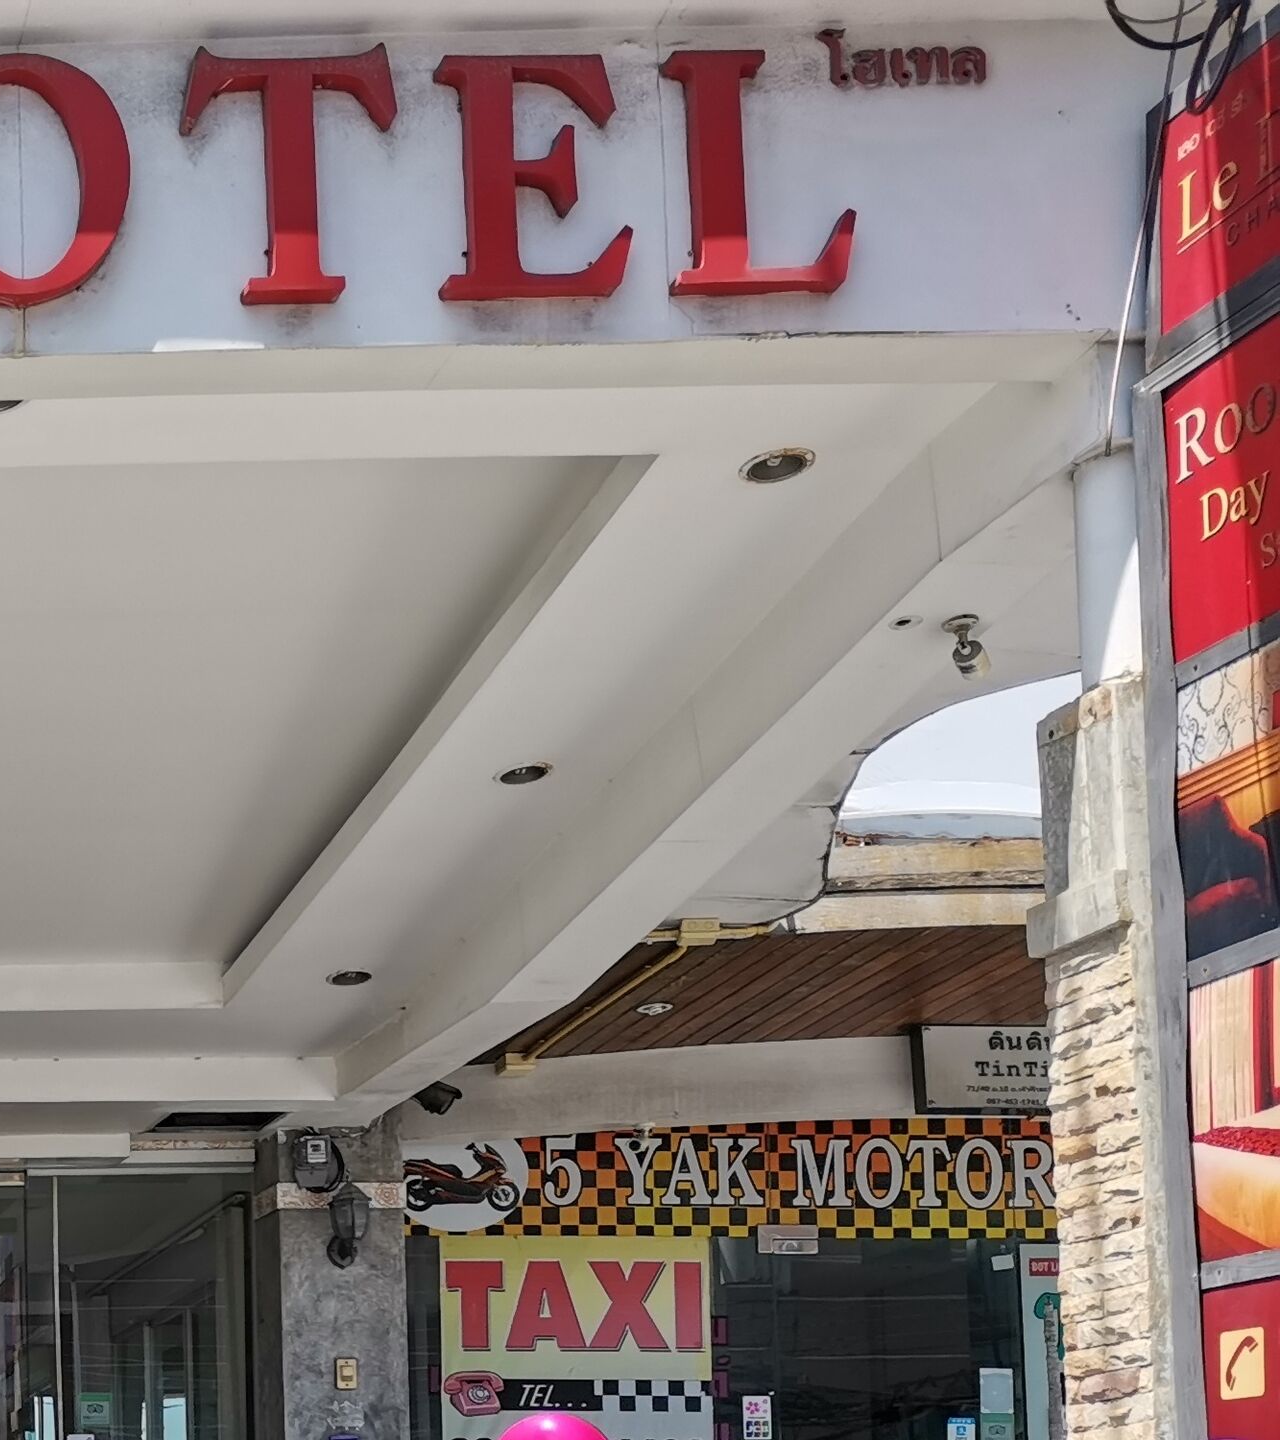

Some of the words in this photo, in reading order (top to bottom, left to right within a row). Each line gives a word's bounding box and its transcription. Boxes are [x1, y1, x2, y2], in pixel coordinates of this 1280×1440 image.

[1176, 160, 1239, 245] Le
[1199, 470, 1271, 543] Day
[542, 1134, 583, 1207] 5
[615, 1137, 765, 1207] YAK
[792, 1138, 1056, 1210] MOTOR
[444, 1259, 707, 1353] TAXI
